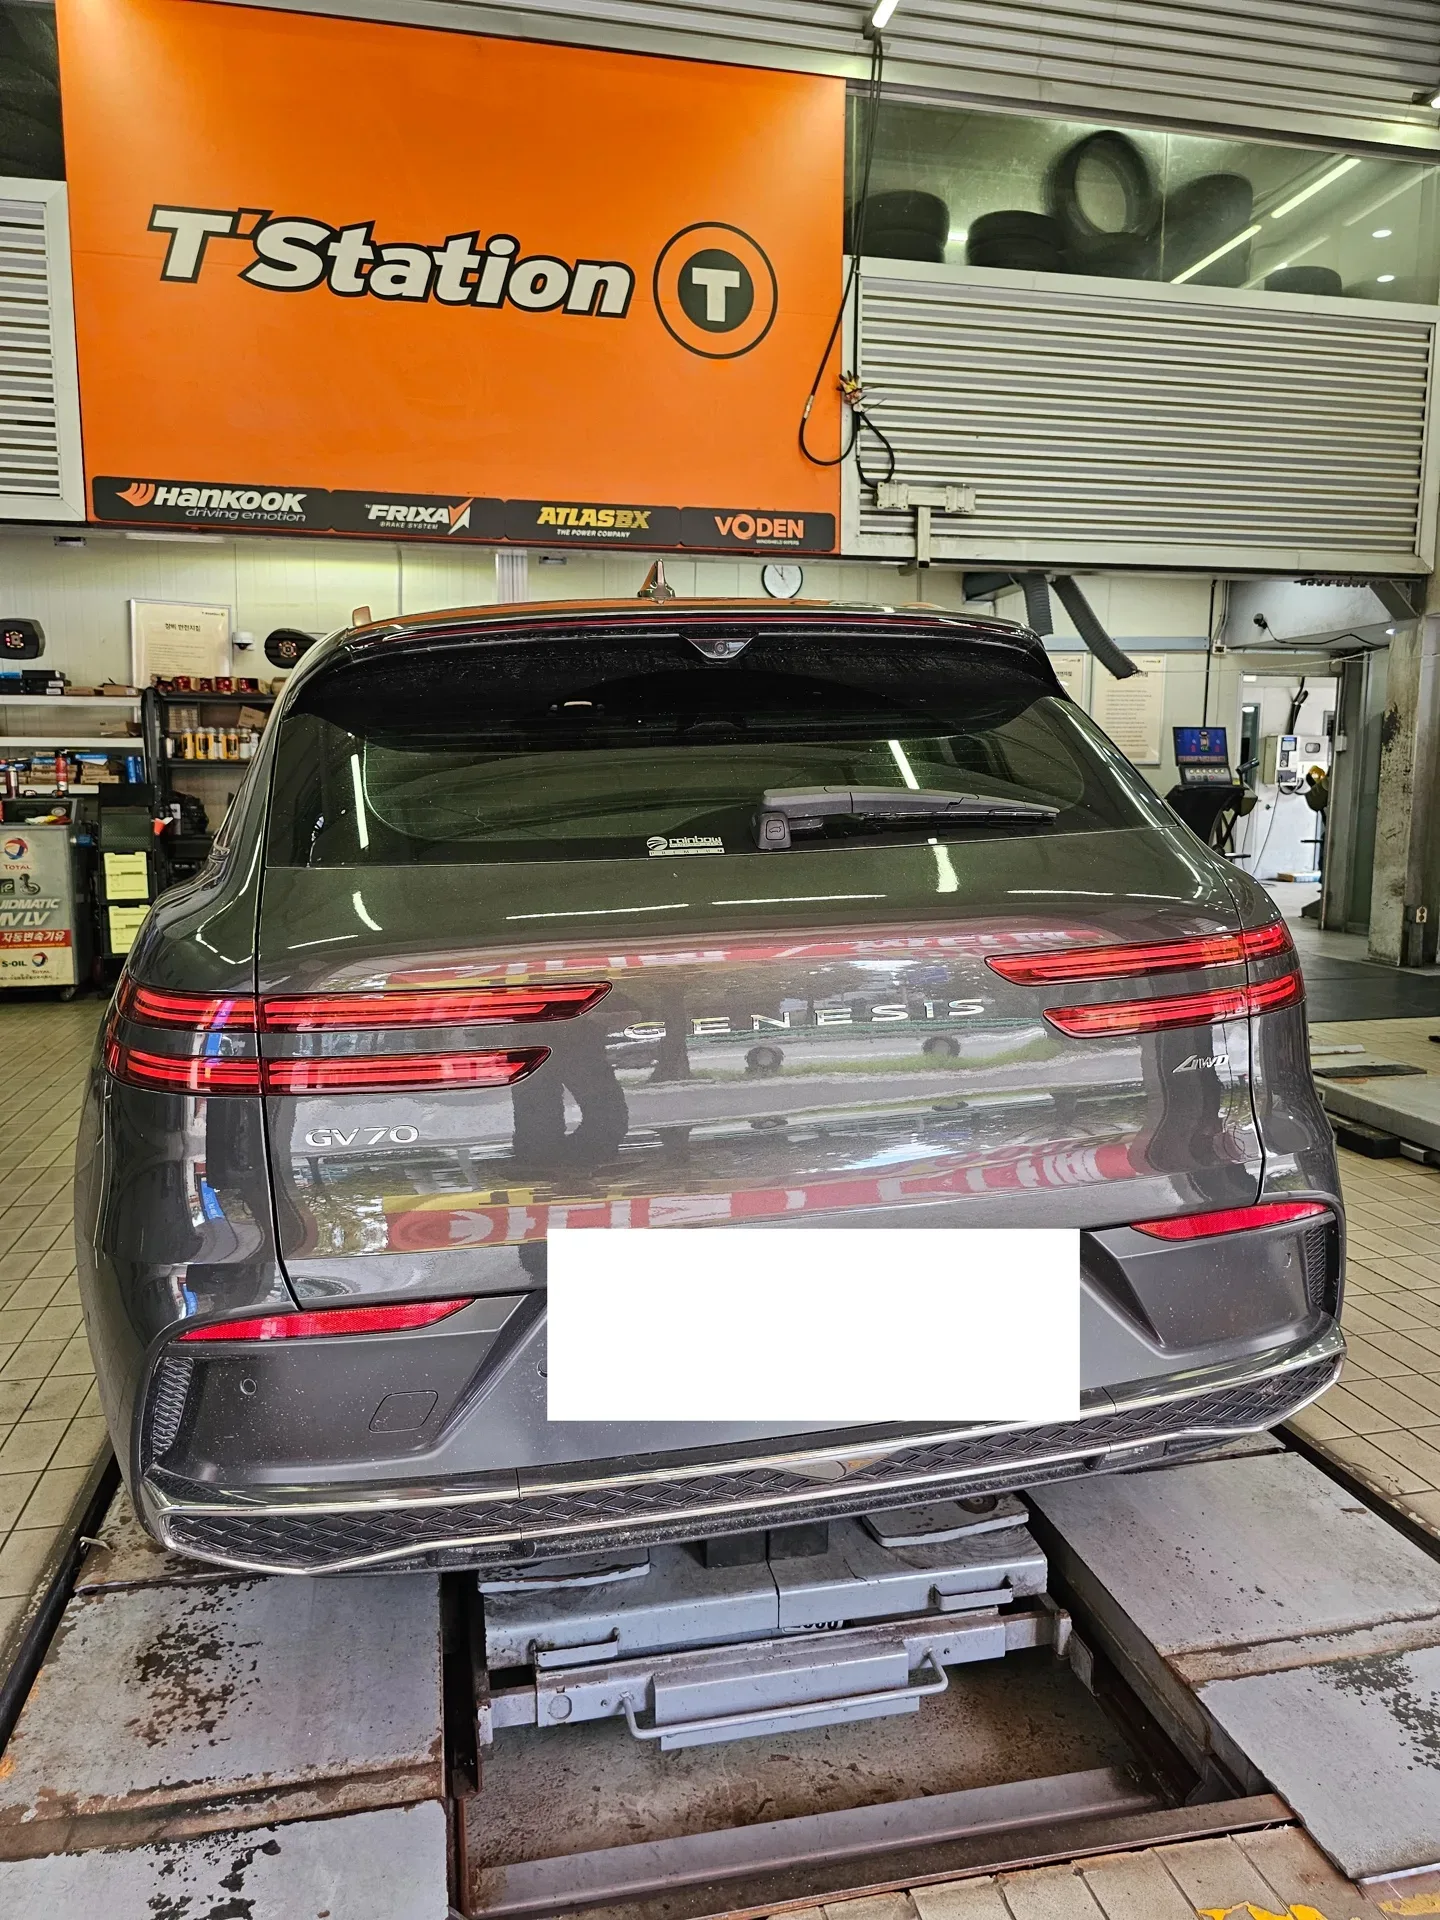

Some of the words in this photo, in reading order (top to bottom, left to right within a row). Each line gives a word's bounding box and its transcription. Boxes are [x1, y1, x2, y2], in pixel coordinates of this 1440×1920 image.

[147, 203, 636, 319] T'Station
[692, 267, 741, 322] T
[185, 507, 239, 520] driving
[241, 512, 306, 522] emotion
[368, 504, 450, 524] FRIXA
[537, 506, 651, 529] ATLASBX
[380, 521, 405, 529] BRAKE
[407, 522, 439, 530] SYSTEM
[571, 529, 597, 537] POWER
[597, 530, 630, 538] COMPANY
[714, 513, 804, 540] VODEN
[669, 835, 722, 845] rainbow
[2, 931, 65, 943] 자동변속기유
[2, 960, 27, 968] S-OIL
[623, 998, 985, 1040] GENESIS
[305, 1125, 419, 1147] GV70
